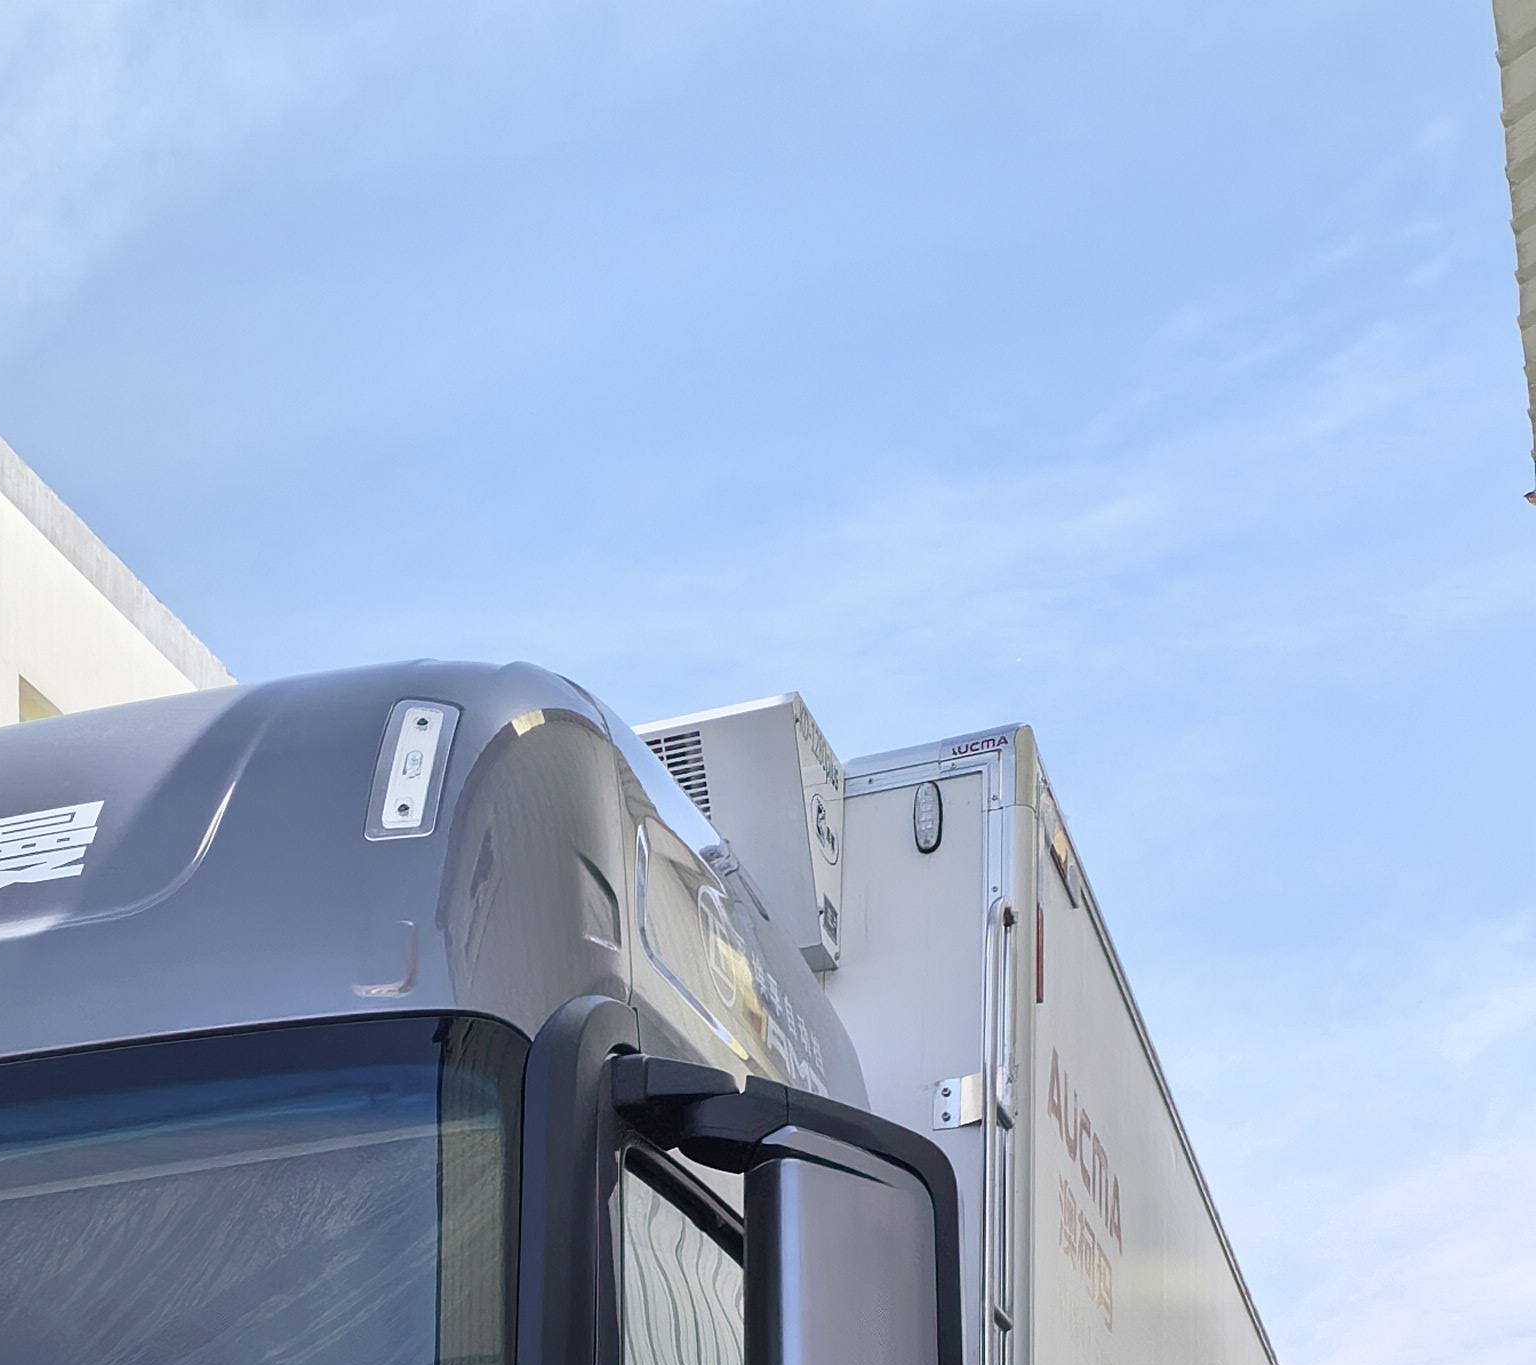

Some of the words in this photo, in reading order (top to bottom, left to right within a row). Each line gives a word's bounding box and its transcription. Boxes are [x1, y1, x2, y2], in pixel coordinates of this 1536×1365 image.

[1047, 1046, 1123, 1256] AUCMA
[1058, 1170, 1113, 1334] 澳柯玛
